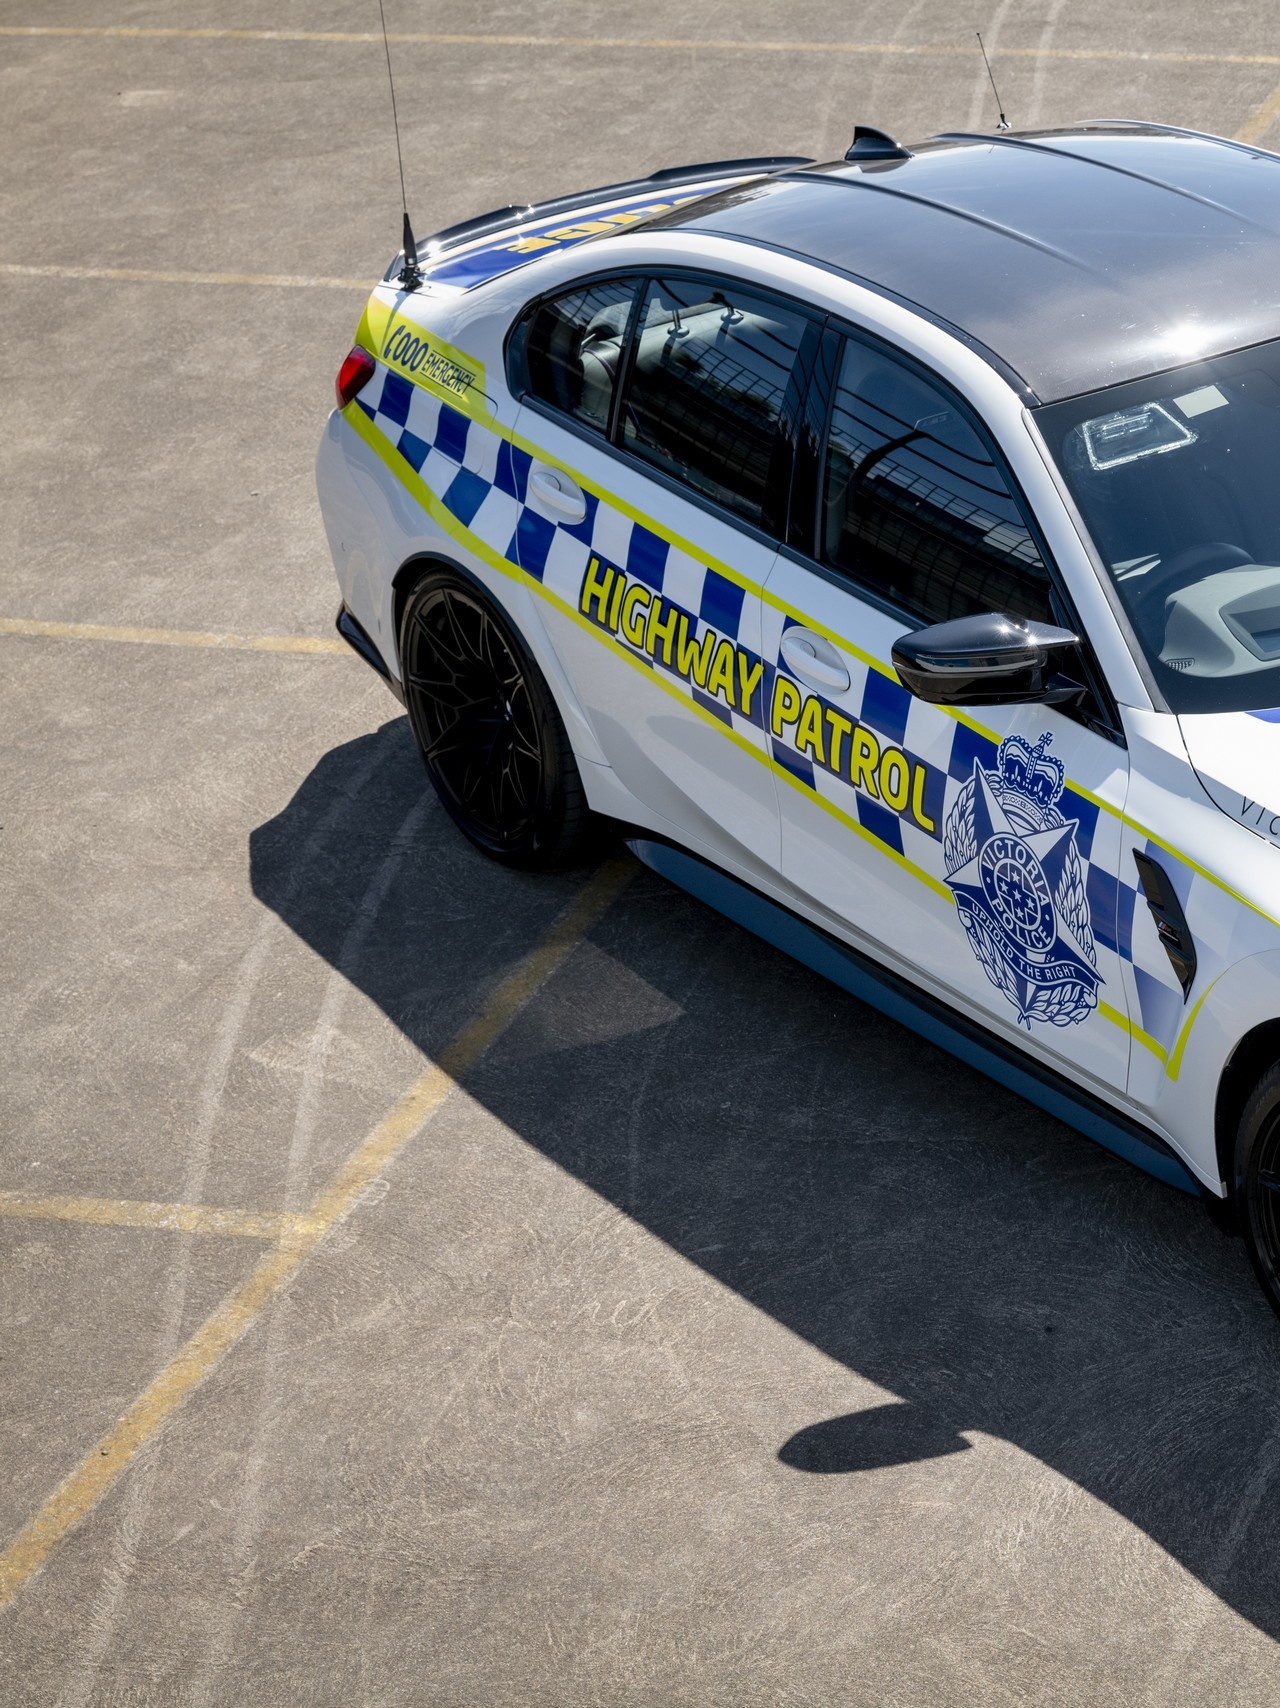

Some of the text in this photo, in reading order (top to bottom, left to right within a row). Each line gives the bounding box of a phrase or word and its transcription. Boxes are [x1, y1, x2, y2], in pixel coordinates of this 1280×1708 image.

[421, 353, 475, 395] EMERGENCY
[579, 556, 936, 834] HIGHWAY PATROL
[981, 839, 1050, 907] VICTORIA
[971, 903, 1077, 981] UPHOLD THE RIGHT
[991, 898, 1052, 949] POLICE
